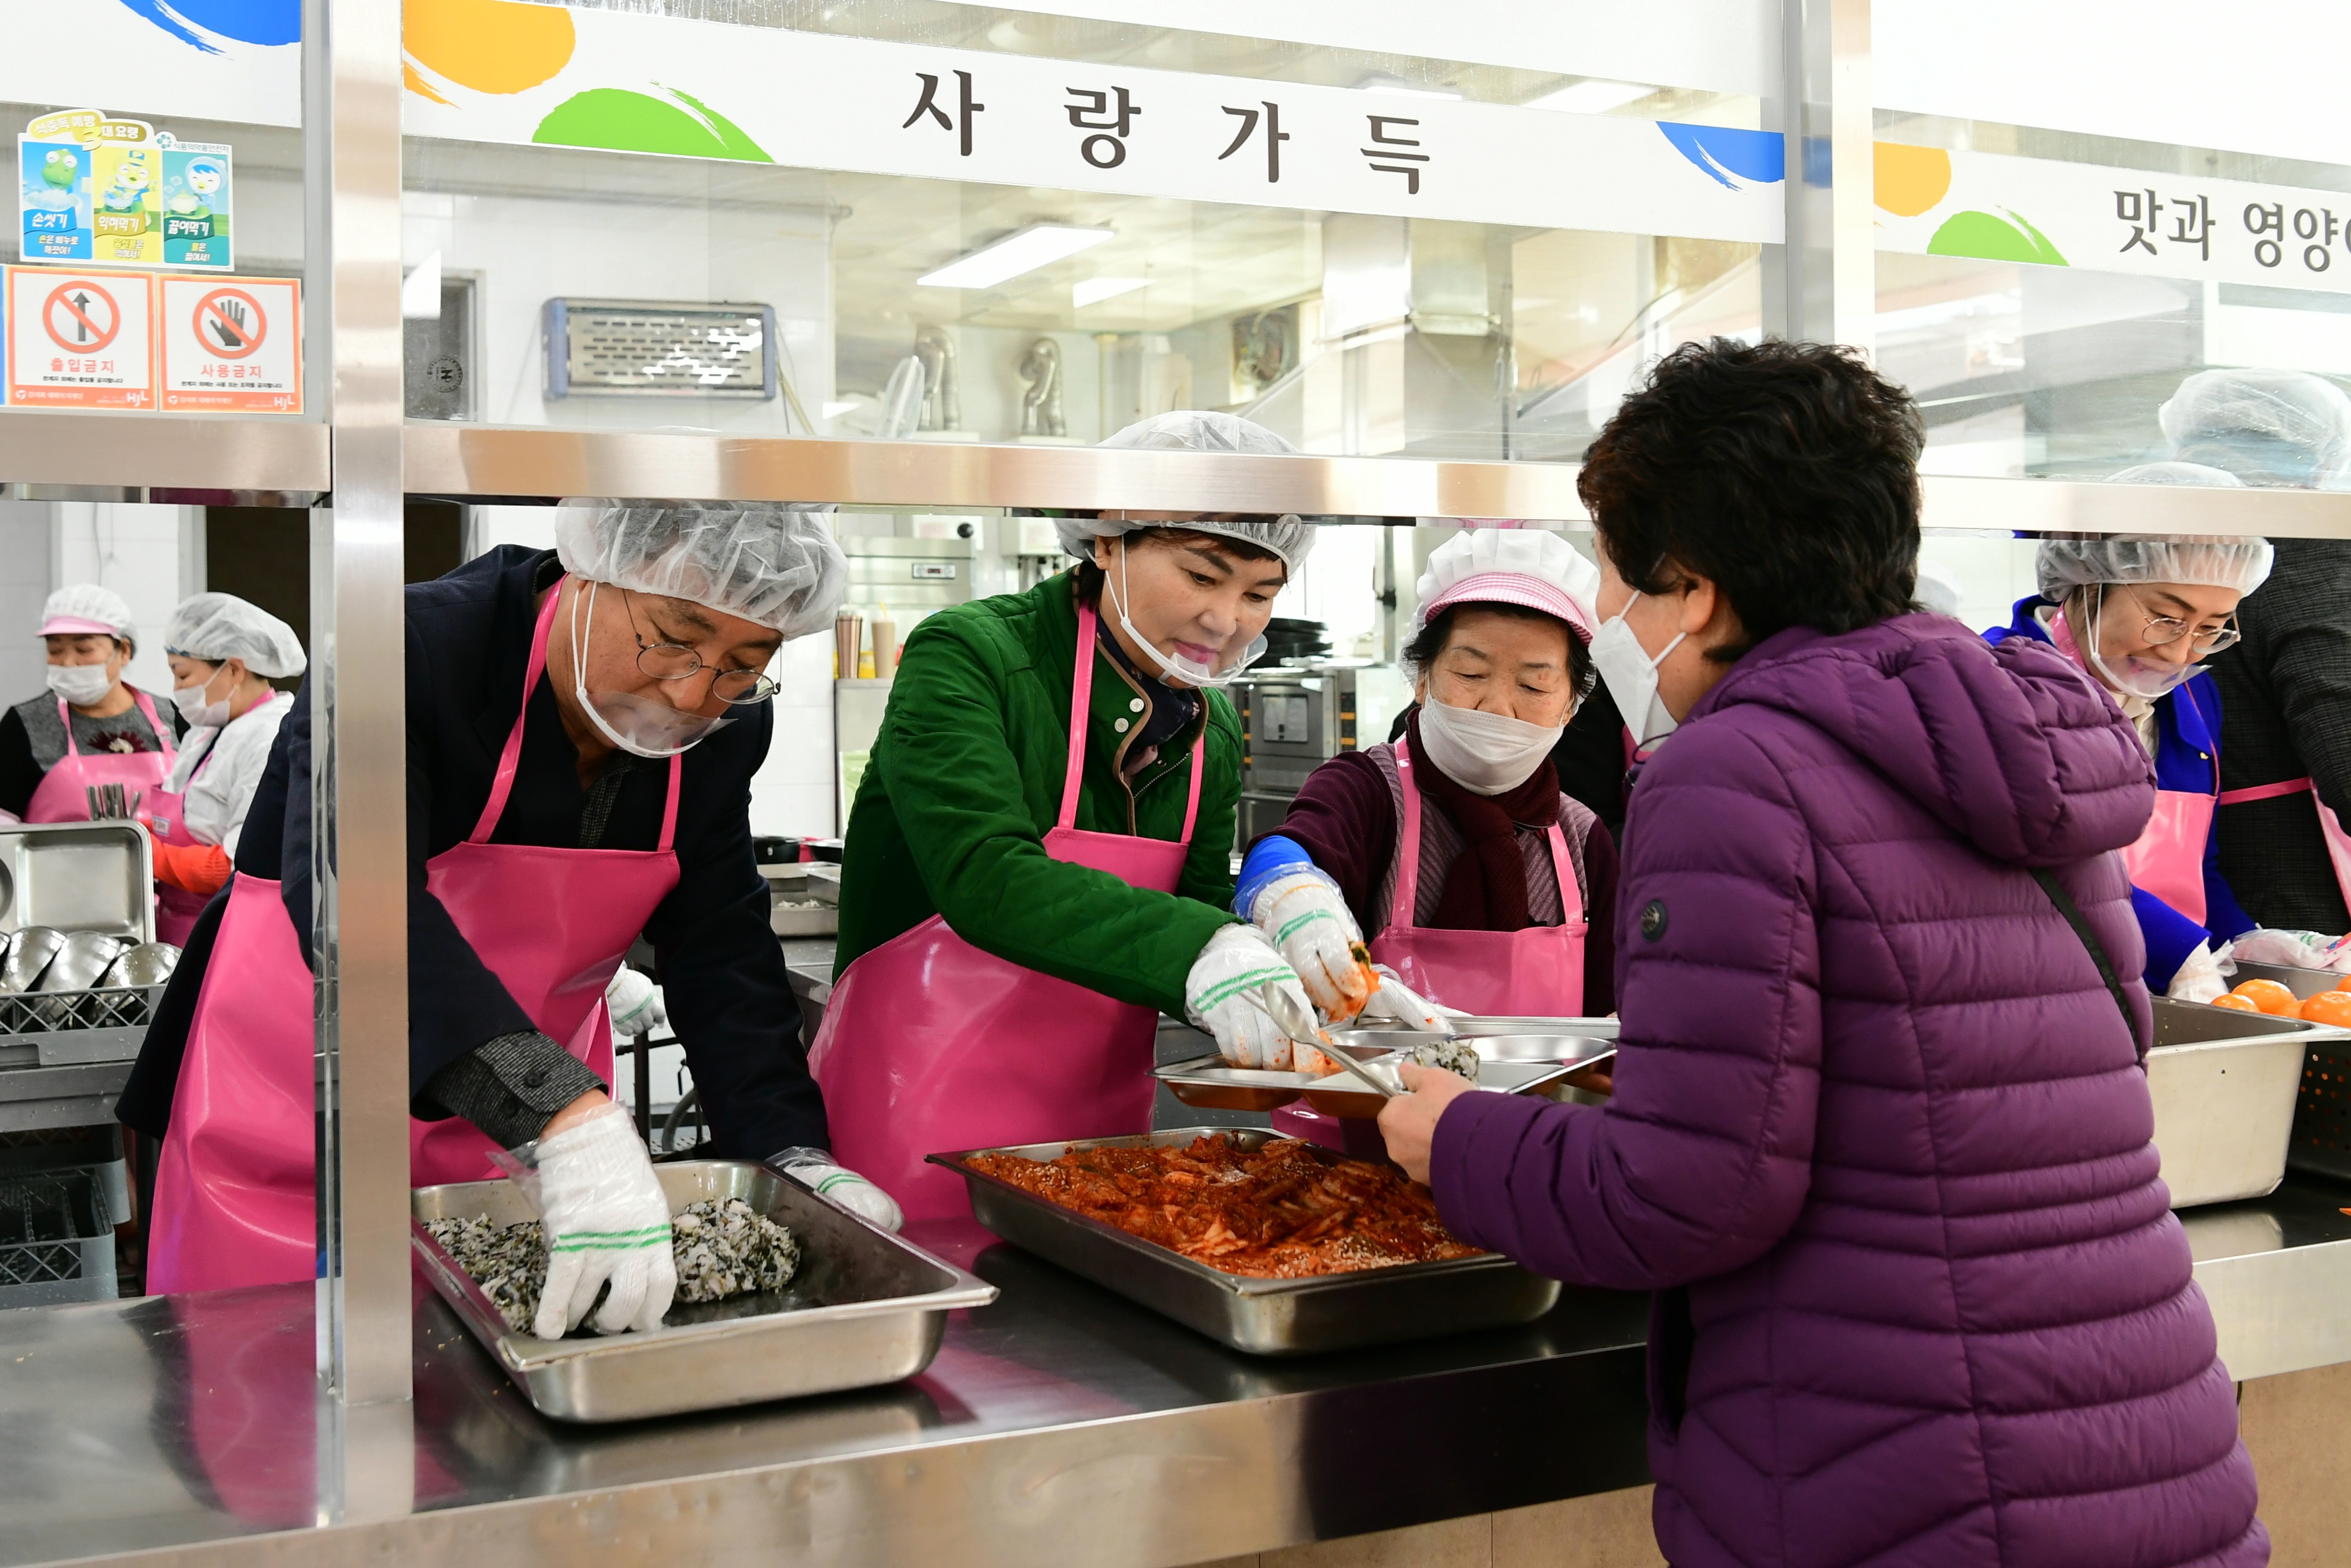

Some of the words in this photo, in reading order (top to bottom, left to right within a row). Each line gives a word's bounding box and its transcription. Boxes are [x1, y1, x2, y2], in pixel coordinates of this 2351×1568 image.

[32, 212, 68, 229] 손씻기
[98, 216, 140, 233] 익혀먹기
[168, 220, 210, 237] 끓여먹기
[2113, 188, 2216, 261] 맛과
[2243, 202, 2351, 272] 영양
[38, 234, 54, 245] 손은
[51, 358, 114, 373] 출입금지
[201, 364, 262, 379] 사용금지
